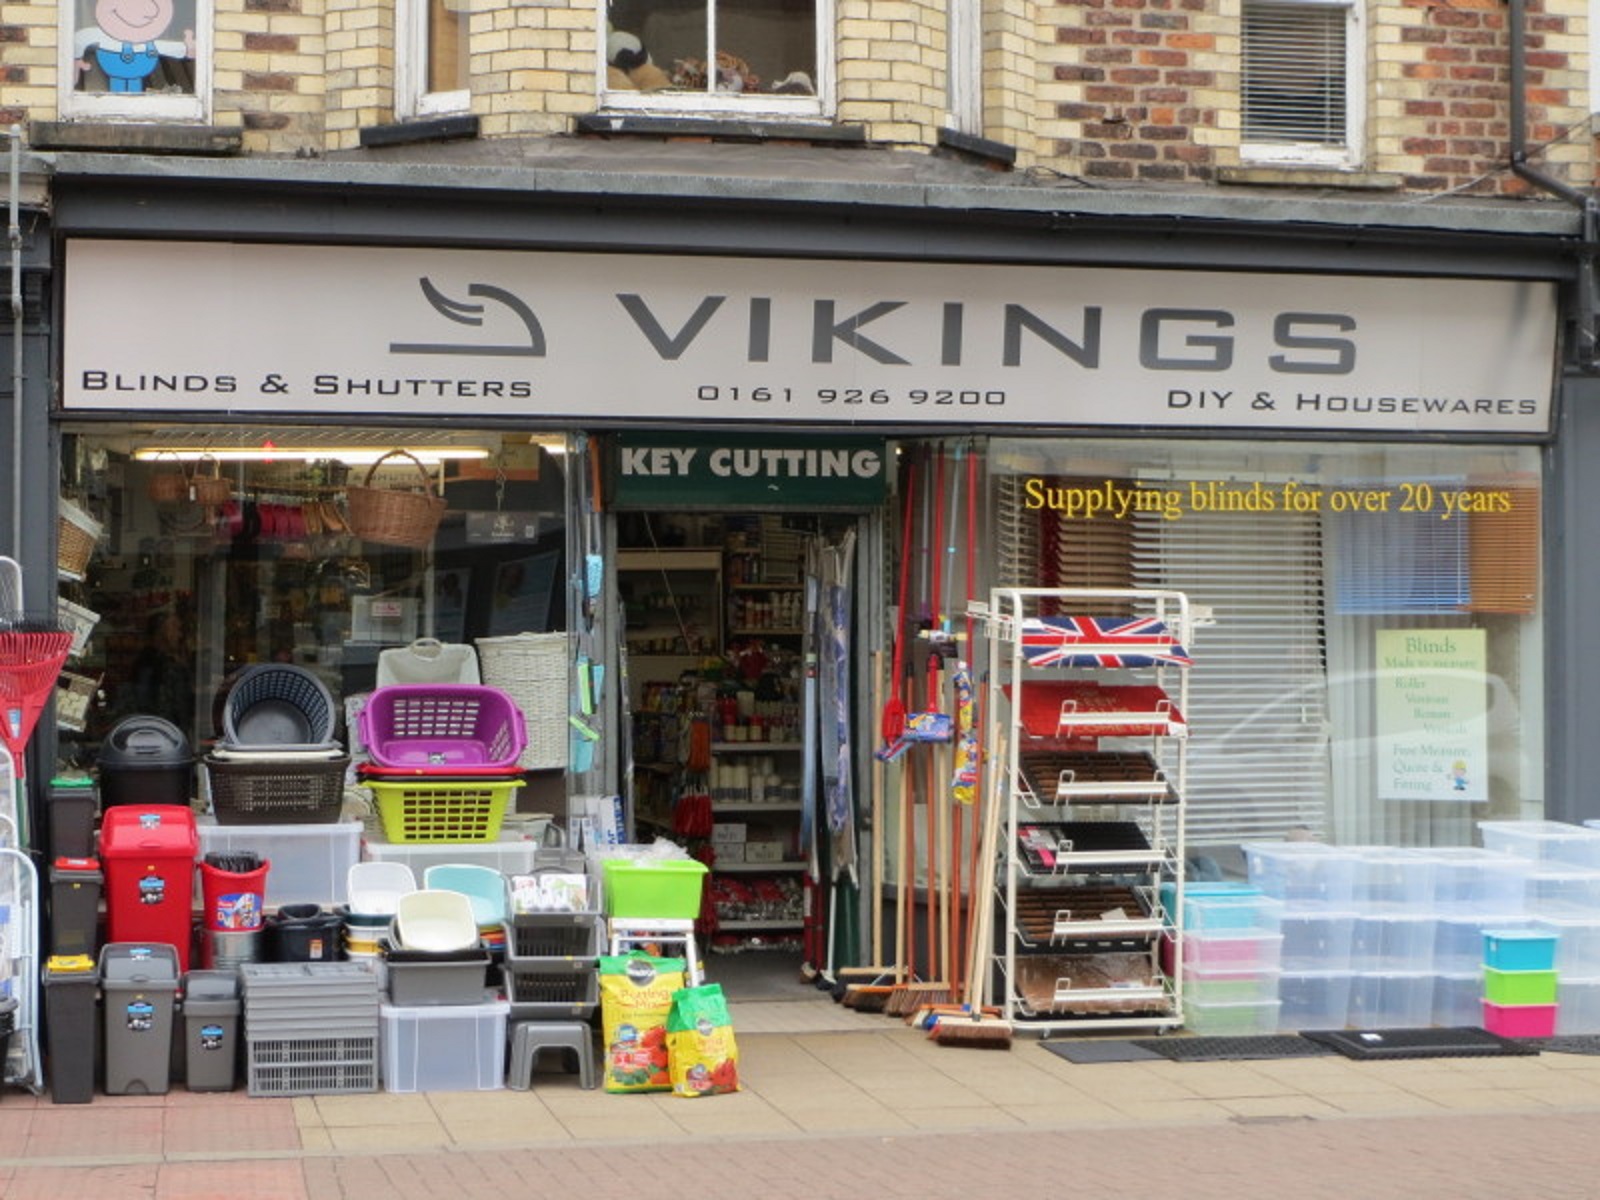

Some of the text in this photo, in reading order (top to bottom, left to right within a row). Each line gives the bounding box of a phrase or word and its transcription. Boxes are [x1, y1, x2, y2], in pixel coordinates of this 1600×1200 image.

[616, 294, 1357, 375] VIKINGS
[82, 372, 532, 398] BLINDS & SHUTTERS
[697, 385, 1005, 405] 0161 926 9200
[1168, 390, 1536, 415] DIY & HOUSEWARES
[621, 447, 881, 478] KEY CUTTING
[1024, 479, 1512, 520] Supplying blinds for over 20 years
[1405, 635, 1457, 654] Blinds
